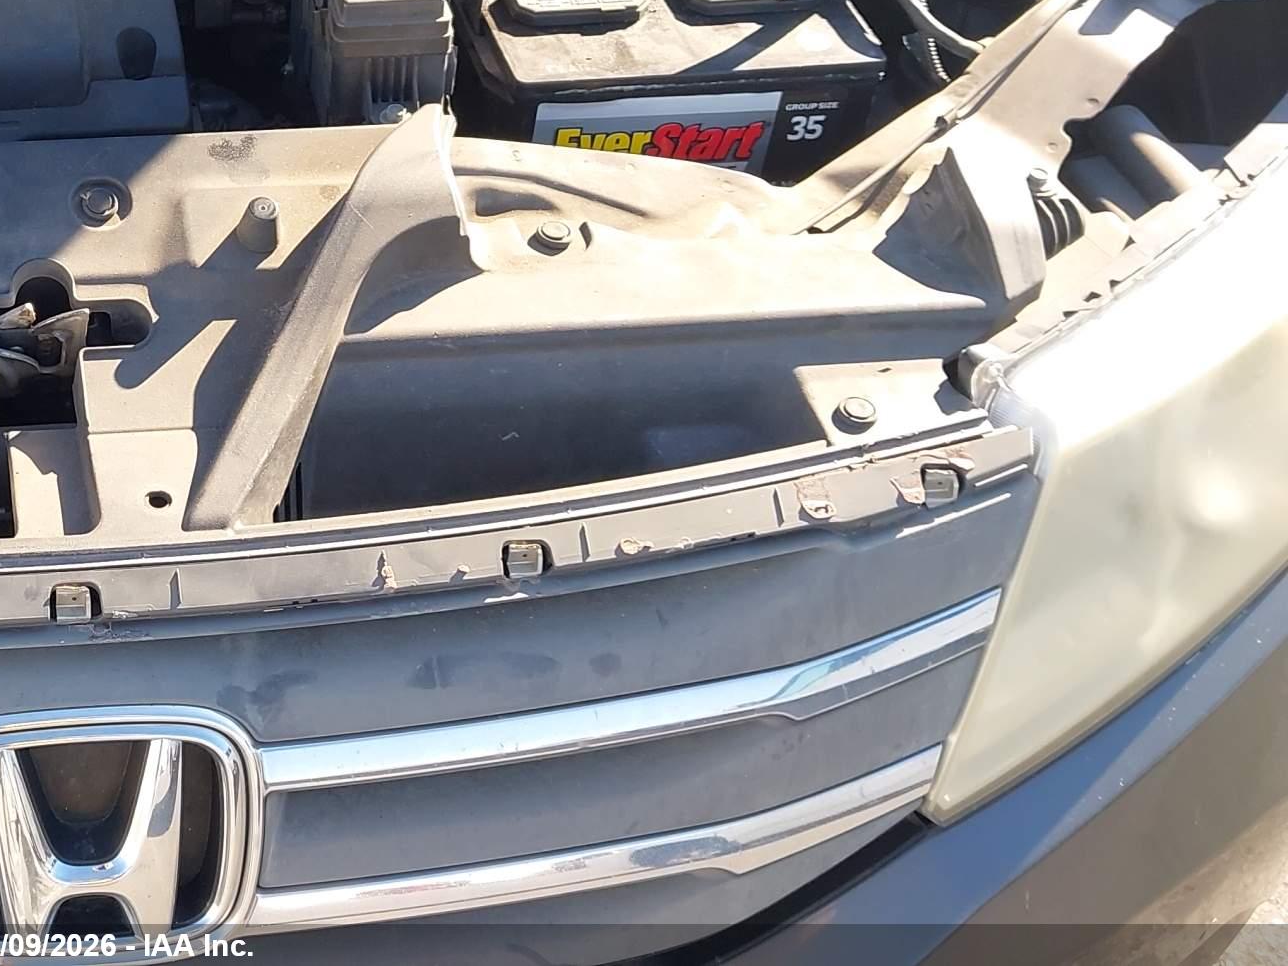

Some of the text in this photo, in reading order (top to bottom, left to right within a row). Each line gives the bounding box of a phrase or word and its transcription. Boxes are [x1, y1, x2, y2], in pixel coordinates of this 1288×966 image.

[785, 101, 840, 111] GROUP SIZE
[786, 114, 826, 141] 35
